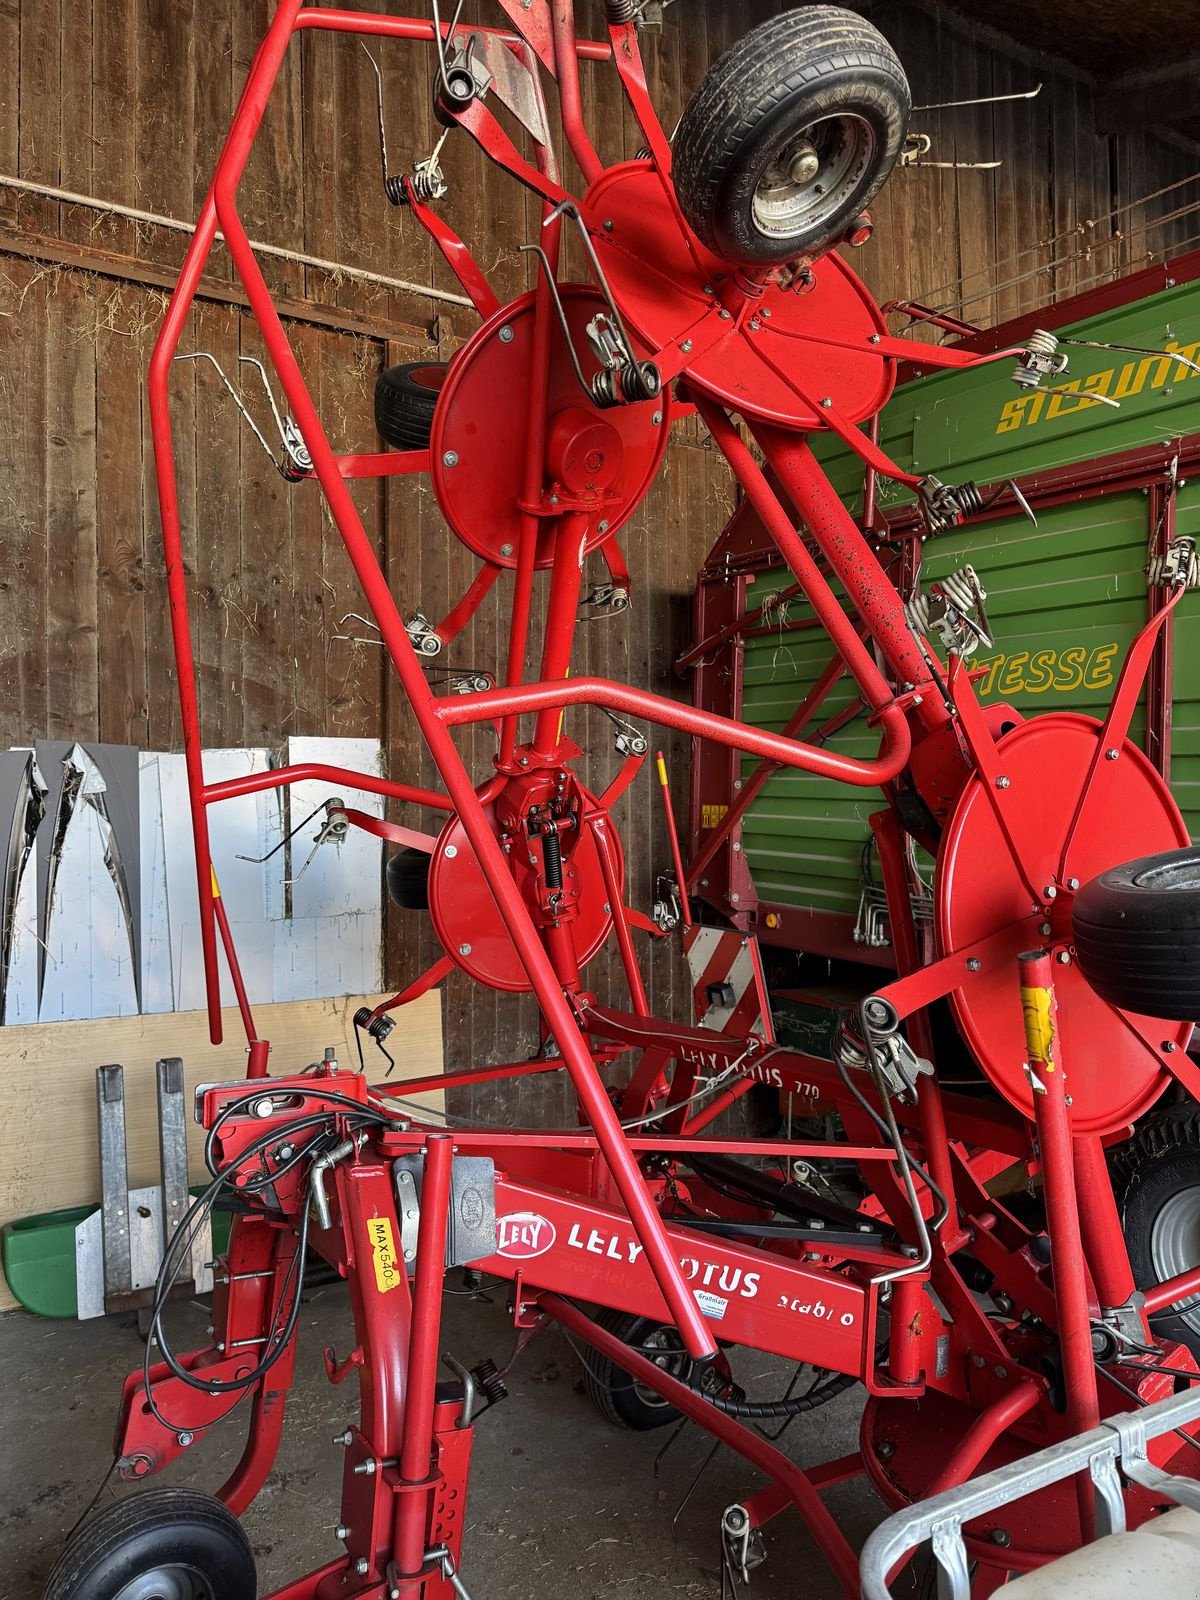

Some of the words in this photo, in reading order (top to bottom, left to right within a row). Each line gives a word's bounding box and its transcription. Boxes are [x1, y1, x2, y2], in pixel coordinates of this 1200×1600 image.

[794, 1080, 820, 1100] 770
[375, 1224, 389, 1253] MAX
[498, 1220, 542, 1249] LELY
[567, 1223, 643, 1263] LELY
[679, 1257, 761, 1298] OTUS
